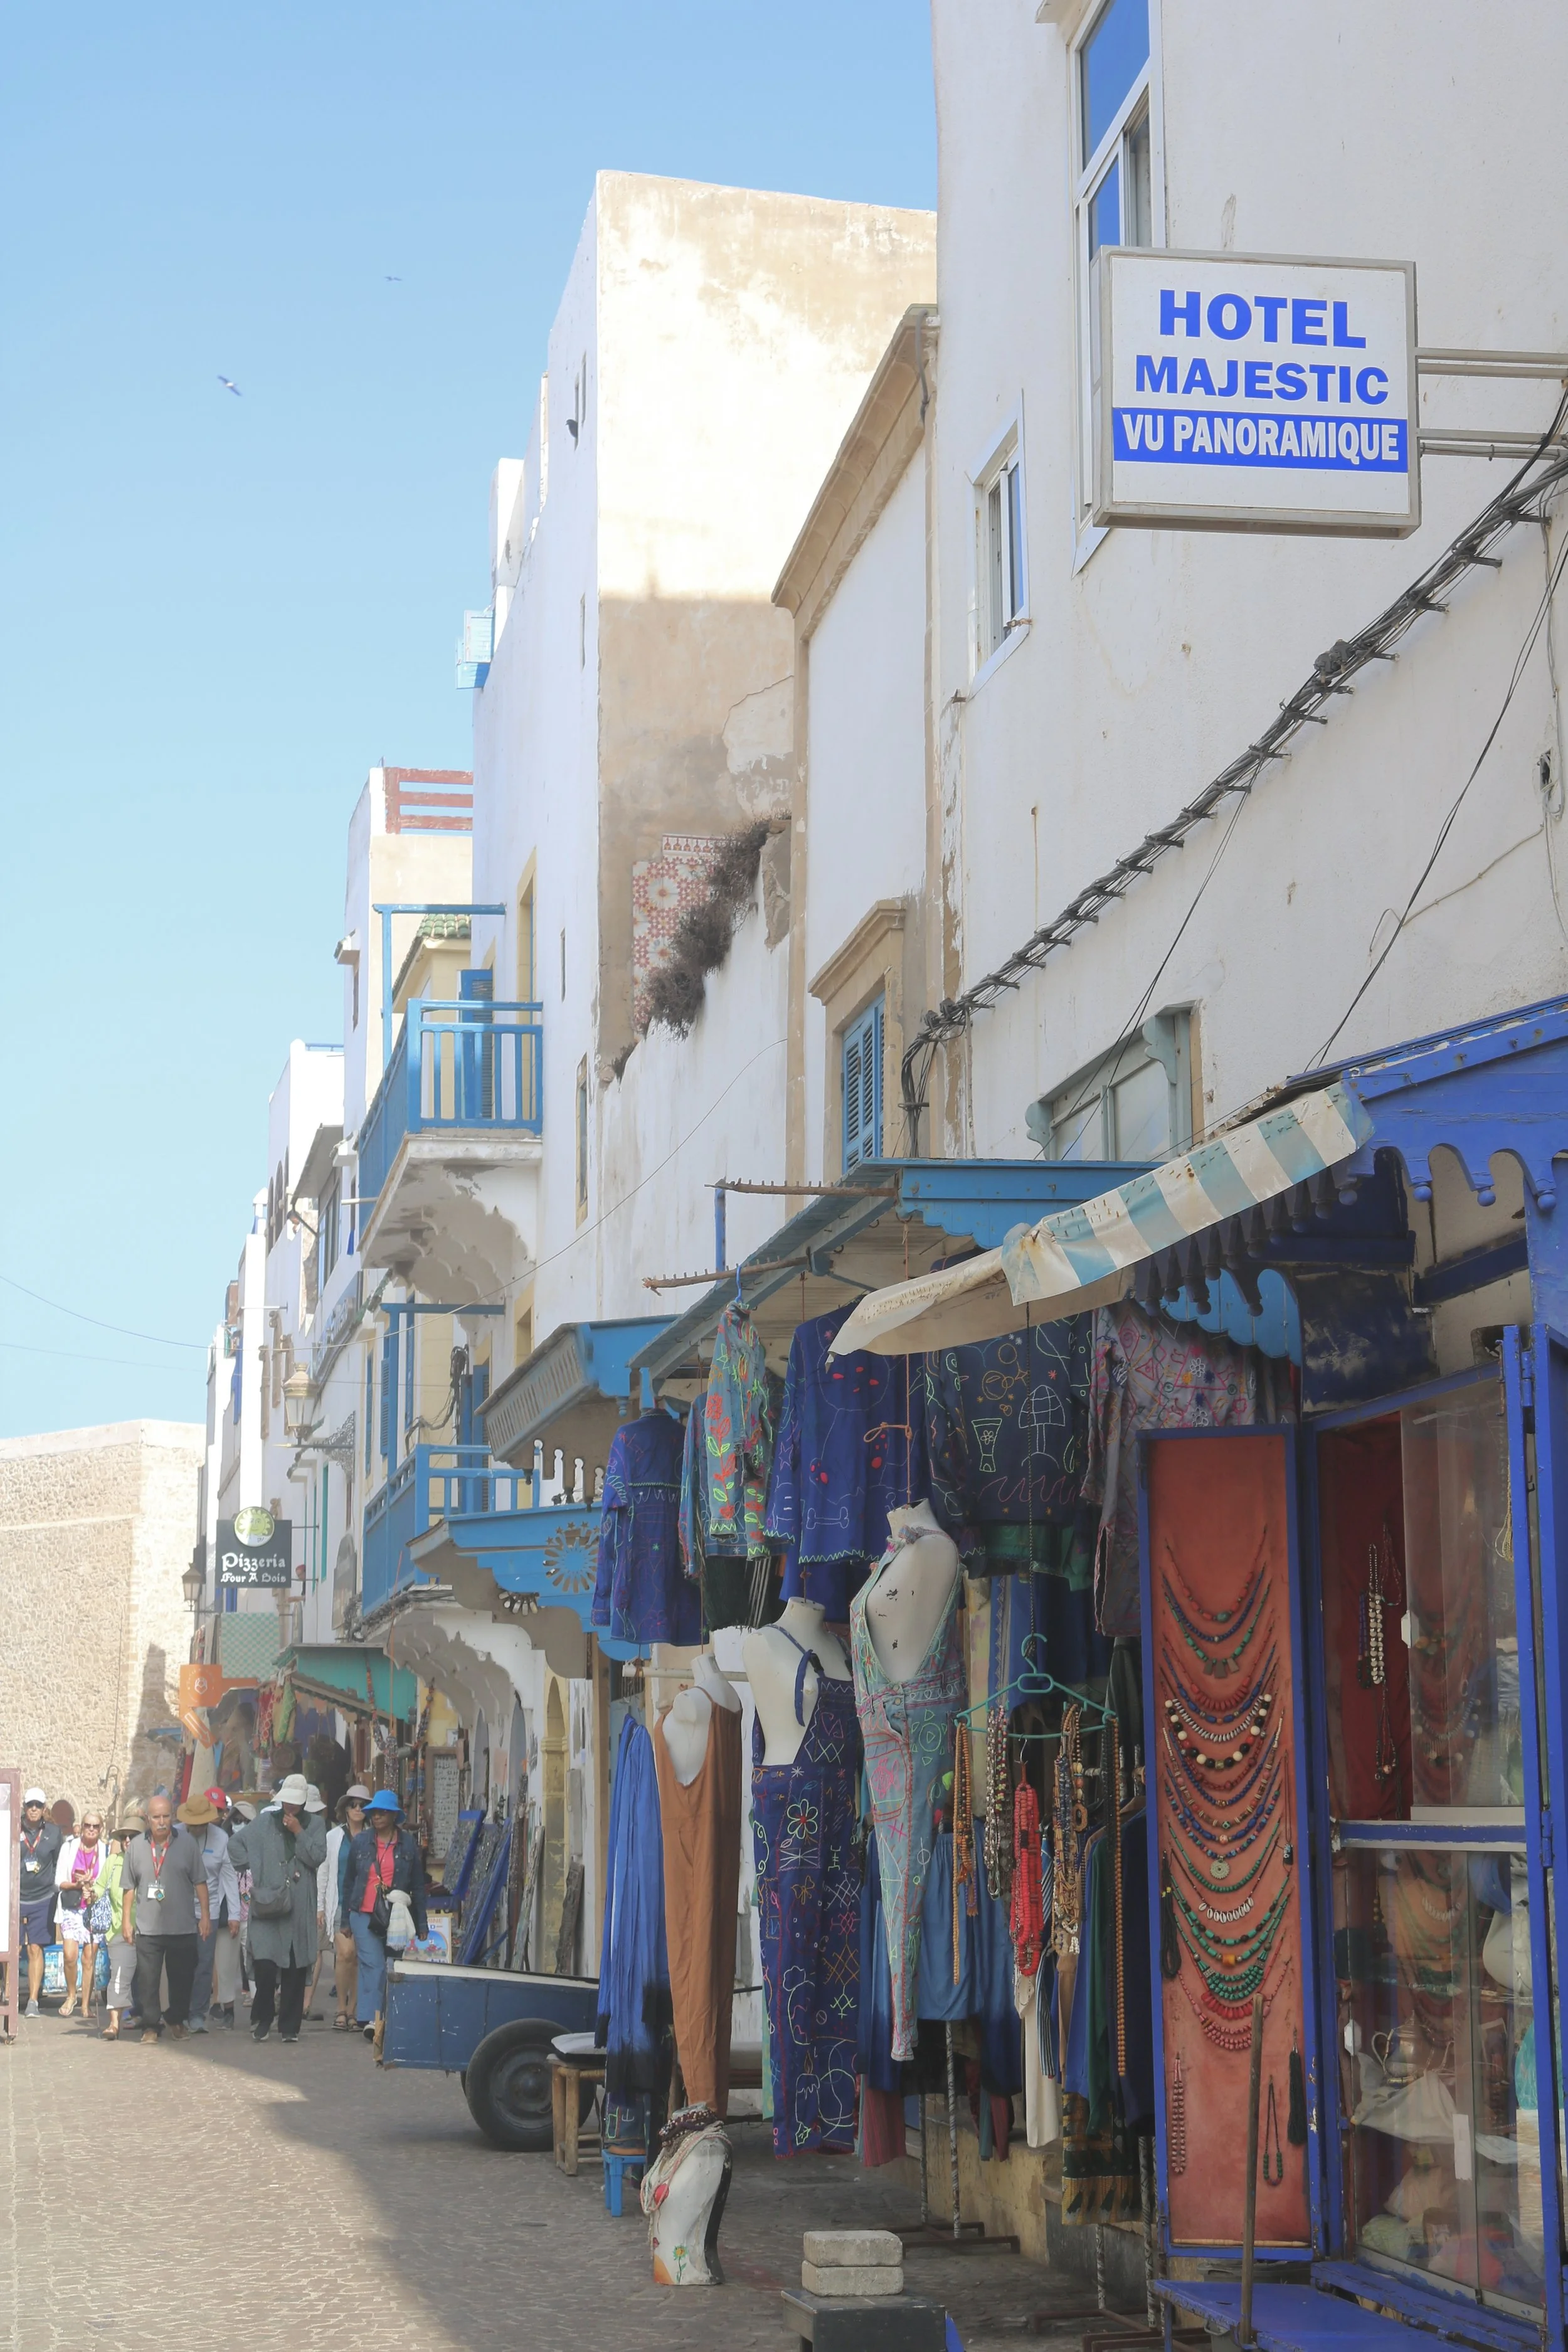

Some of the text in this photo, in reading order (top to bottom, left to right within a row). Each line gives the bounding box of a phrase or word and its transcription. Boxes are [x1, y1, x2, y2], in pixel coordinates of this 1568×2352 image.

[1159, 289, 1367, 349] HOTEL
[1135, 354, 1389, 406] MAJESTIC
[1121, 413, 1399, 465] VU PANORAMIQUE
[220, 1572, 287, 1583] Four A Bois
[221, 1552, 286, 1572] Pizzeria
